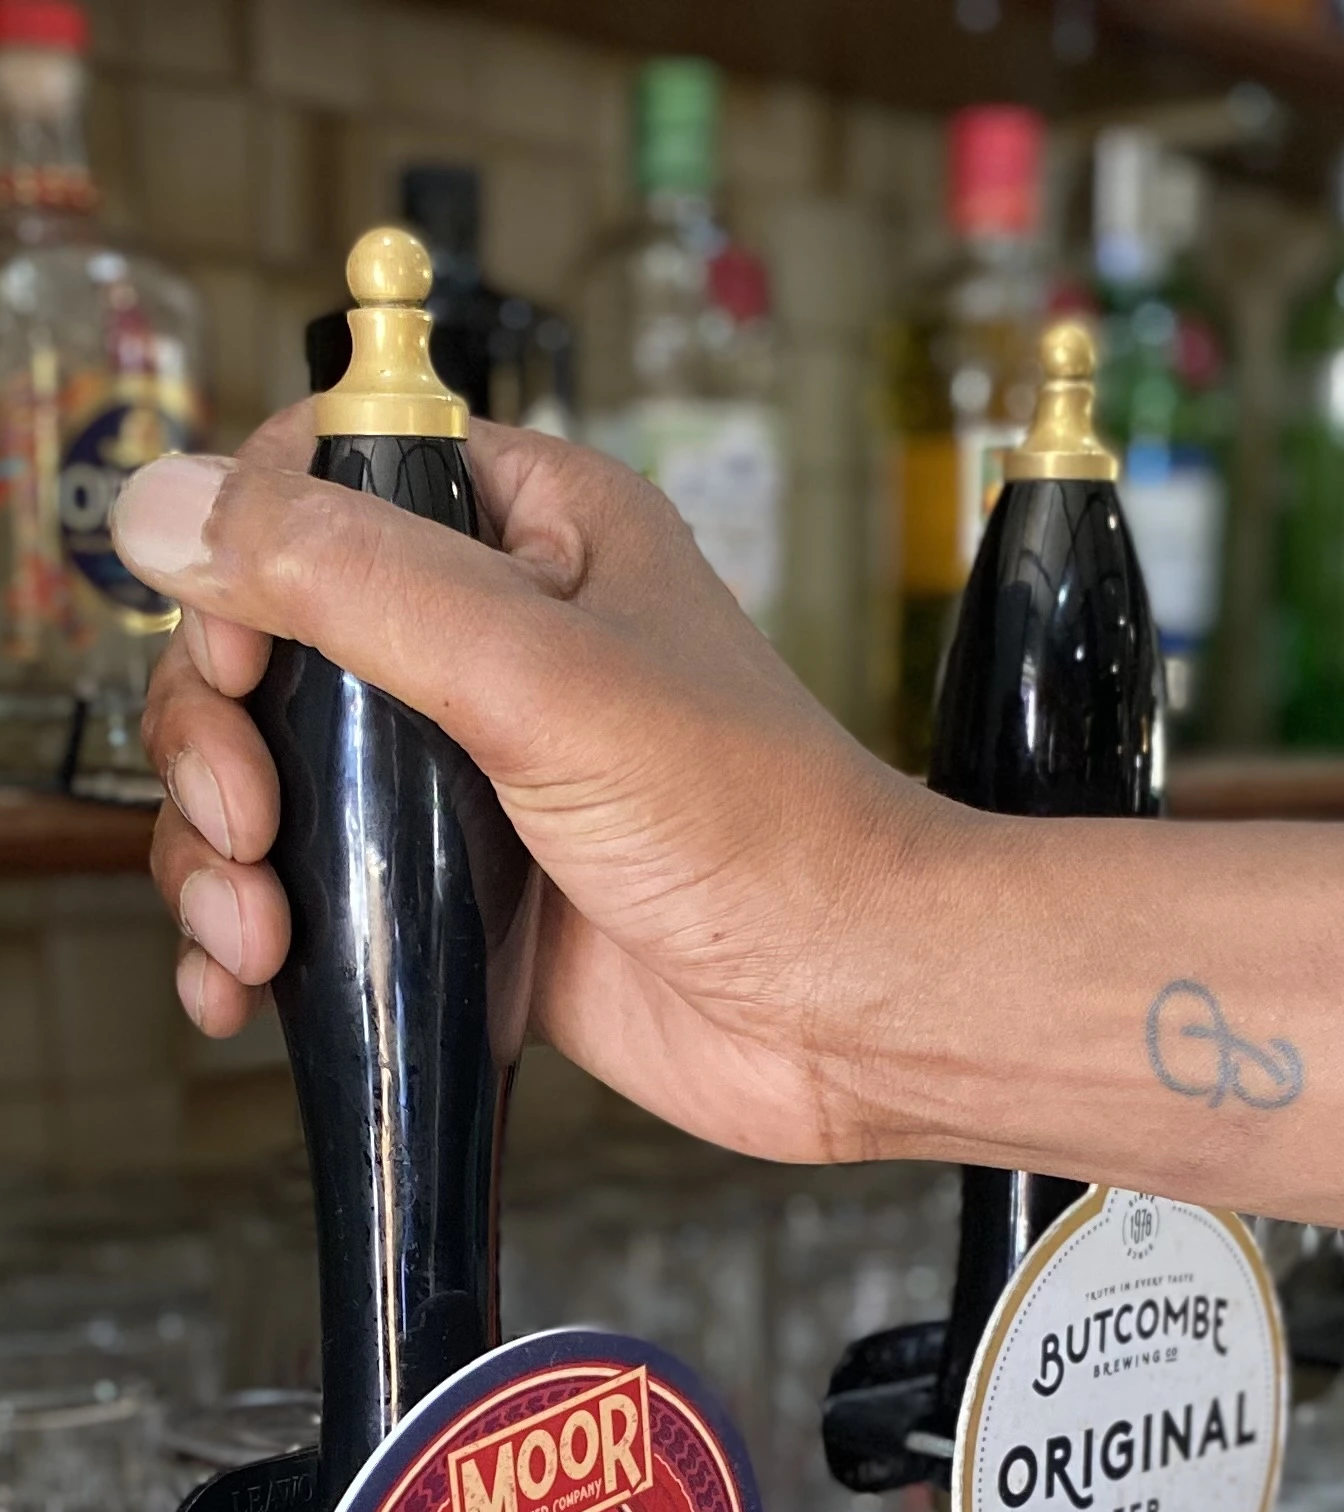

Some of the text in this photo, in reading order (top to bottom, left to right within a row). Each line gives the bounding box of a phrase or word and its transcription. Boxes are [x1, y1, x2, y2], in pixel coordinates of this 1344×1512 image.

[1130, 1209, 1152, 1244] 1978
[1085, 1273, 1194, 1301] TRUTH IN EVERY TASTE
[1032, 1295, 1228, 1397] BUTCOMBE
[1093, 1351, 1161, 1378] BREWING
[997, 1390, 1256, 1510] ORIGINAL
